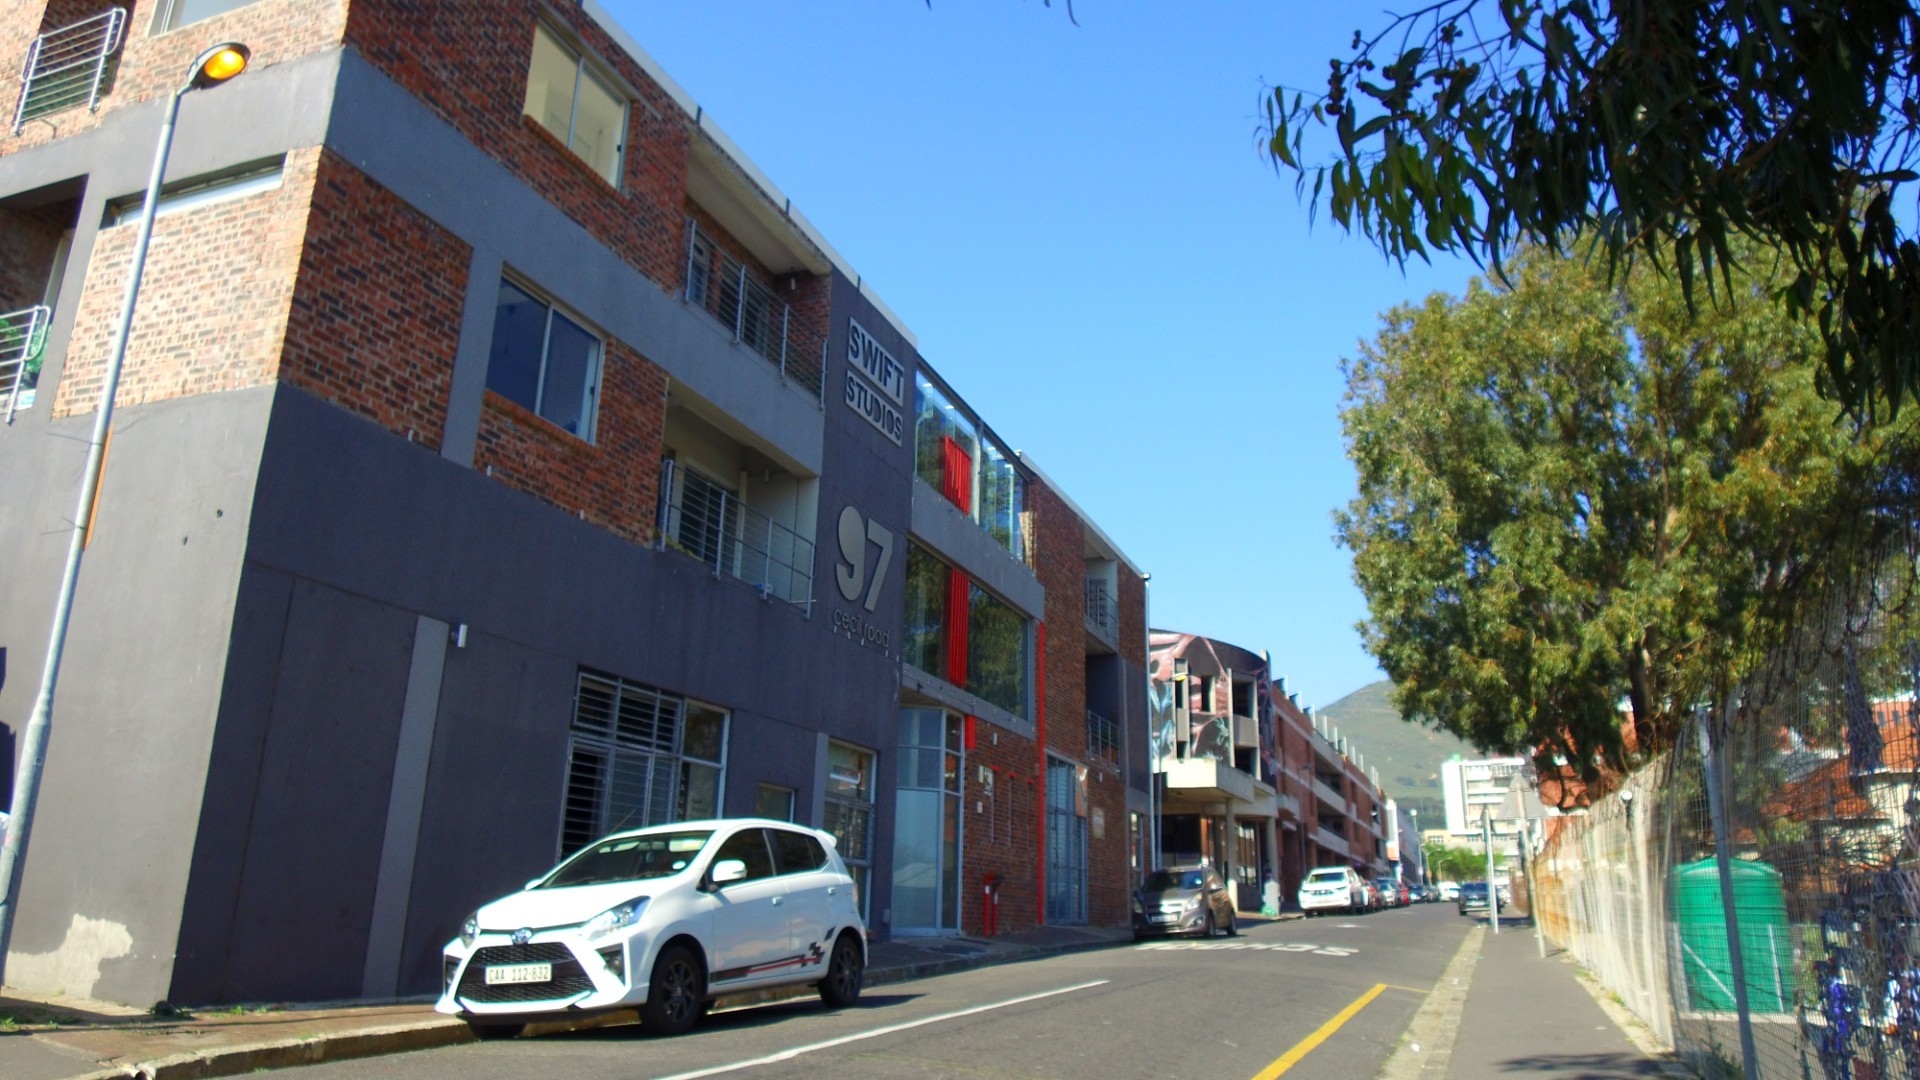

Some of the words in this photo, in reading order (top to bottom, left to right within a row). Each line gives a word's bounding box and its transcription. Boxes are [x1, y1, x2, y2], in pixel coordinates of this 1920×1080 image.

[850, 325, 903, 398] SWIFT
[847, 376, 901, 441] STUDIOS
[836, 506, 893, 612] 97
[833, 609, 862, 635] cecil
[864, 623, 890, 648] road
[489, 969, 505, 982] CAA
